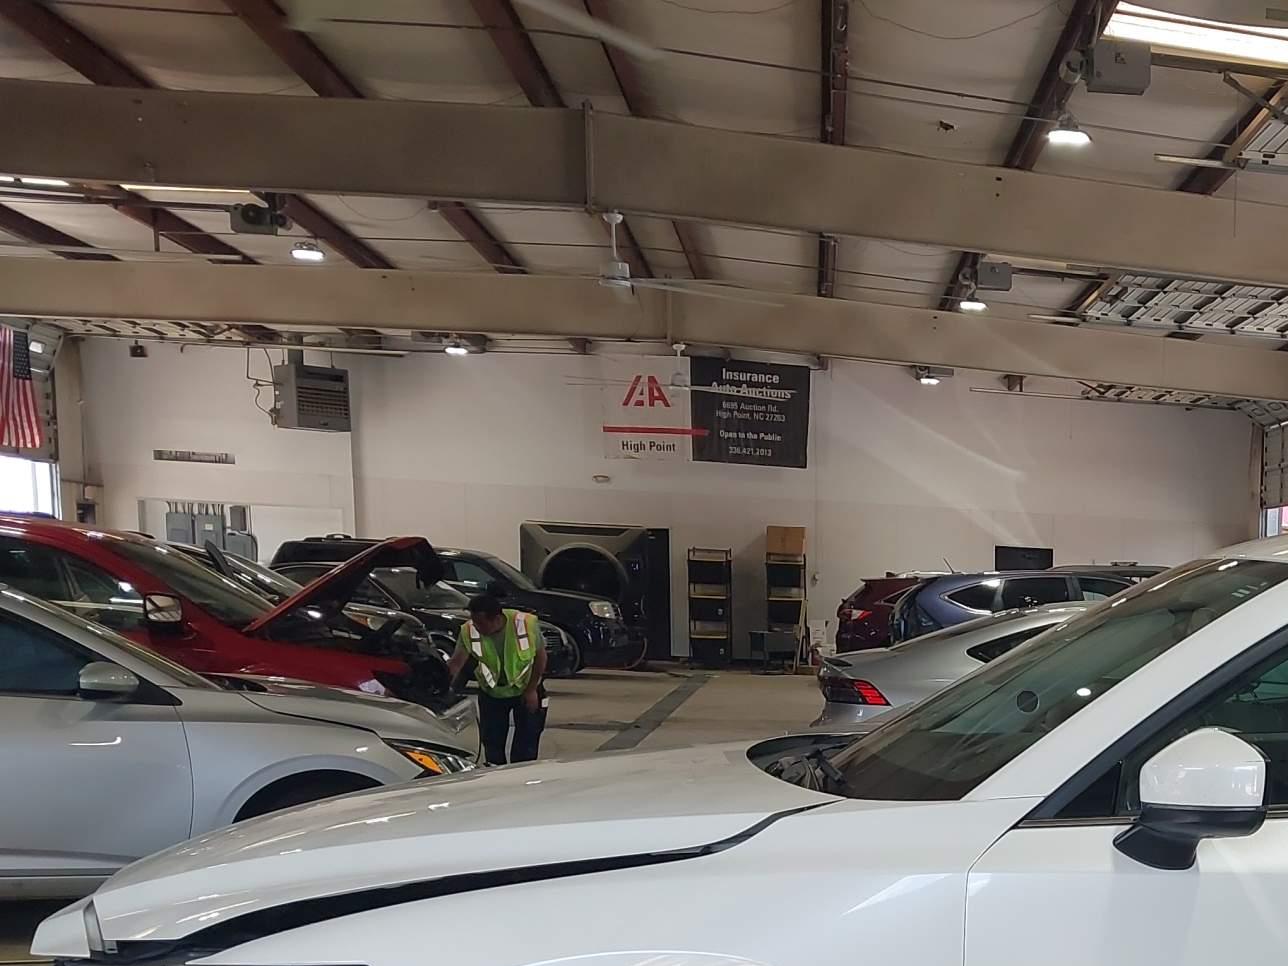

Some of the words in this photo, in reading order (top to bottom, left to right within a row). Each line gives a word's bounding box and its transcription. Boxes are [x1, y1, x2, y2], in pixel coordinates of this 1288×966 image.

[722, 367, 780, 384] Insurance
[740, 383, 792, 399] Auctions
[740, 402, 766, 412] Auction
[715, 409, 732, 419] High
[753, 412, 765, 421] NC
[719, 429, 738, 439] Open
[738, 431, 746, 439] to
[746, 431, 758, 440] the
[759, 431, 782, 442] Public
[621, 440, 646, 453] High
[649, 441, 676, 452] Point
